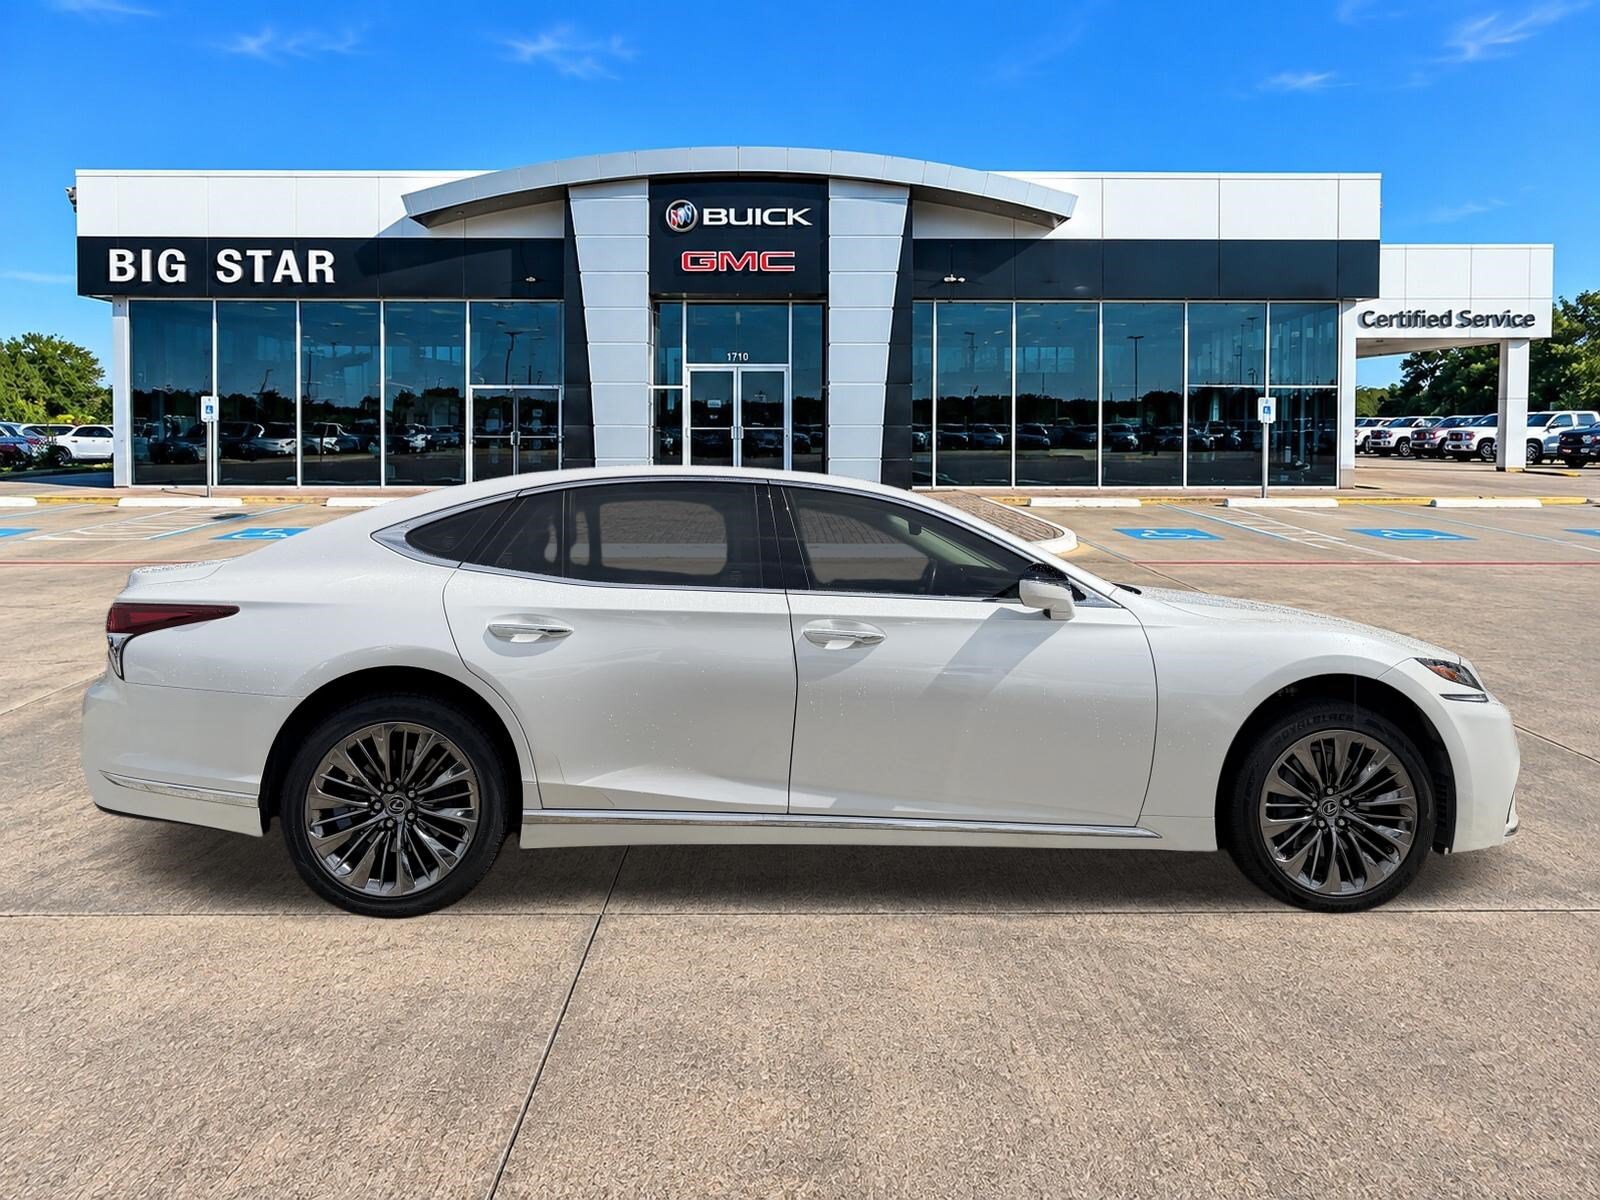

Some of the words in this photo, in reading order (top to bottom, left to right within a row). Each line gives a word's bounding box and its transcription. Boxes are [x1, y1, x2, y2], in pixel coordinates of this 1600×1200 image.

[702, 207, 813, 226] BUICK
[108, 248, 187, 283] BIG
[216, 249, 336, 283] STAR
[681, 251, 795, 272] GMC
[1358, 309, 1453, 328] Certified
[1456, 309, 1536, 328] Service
[726, 352, 750, 361] 1710
